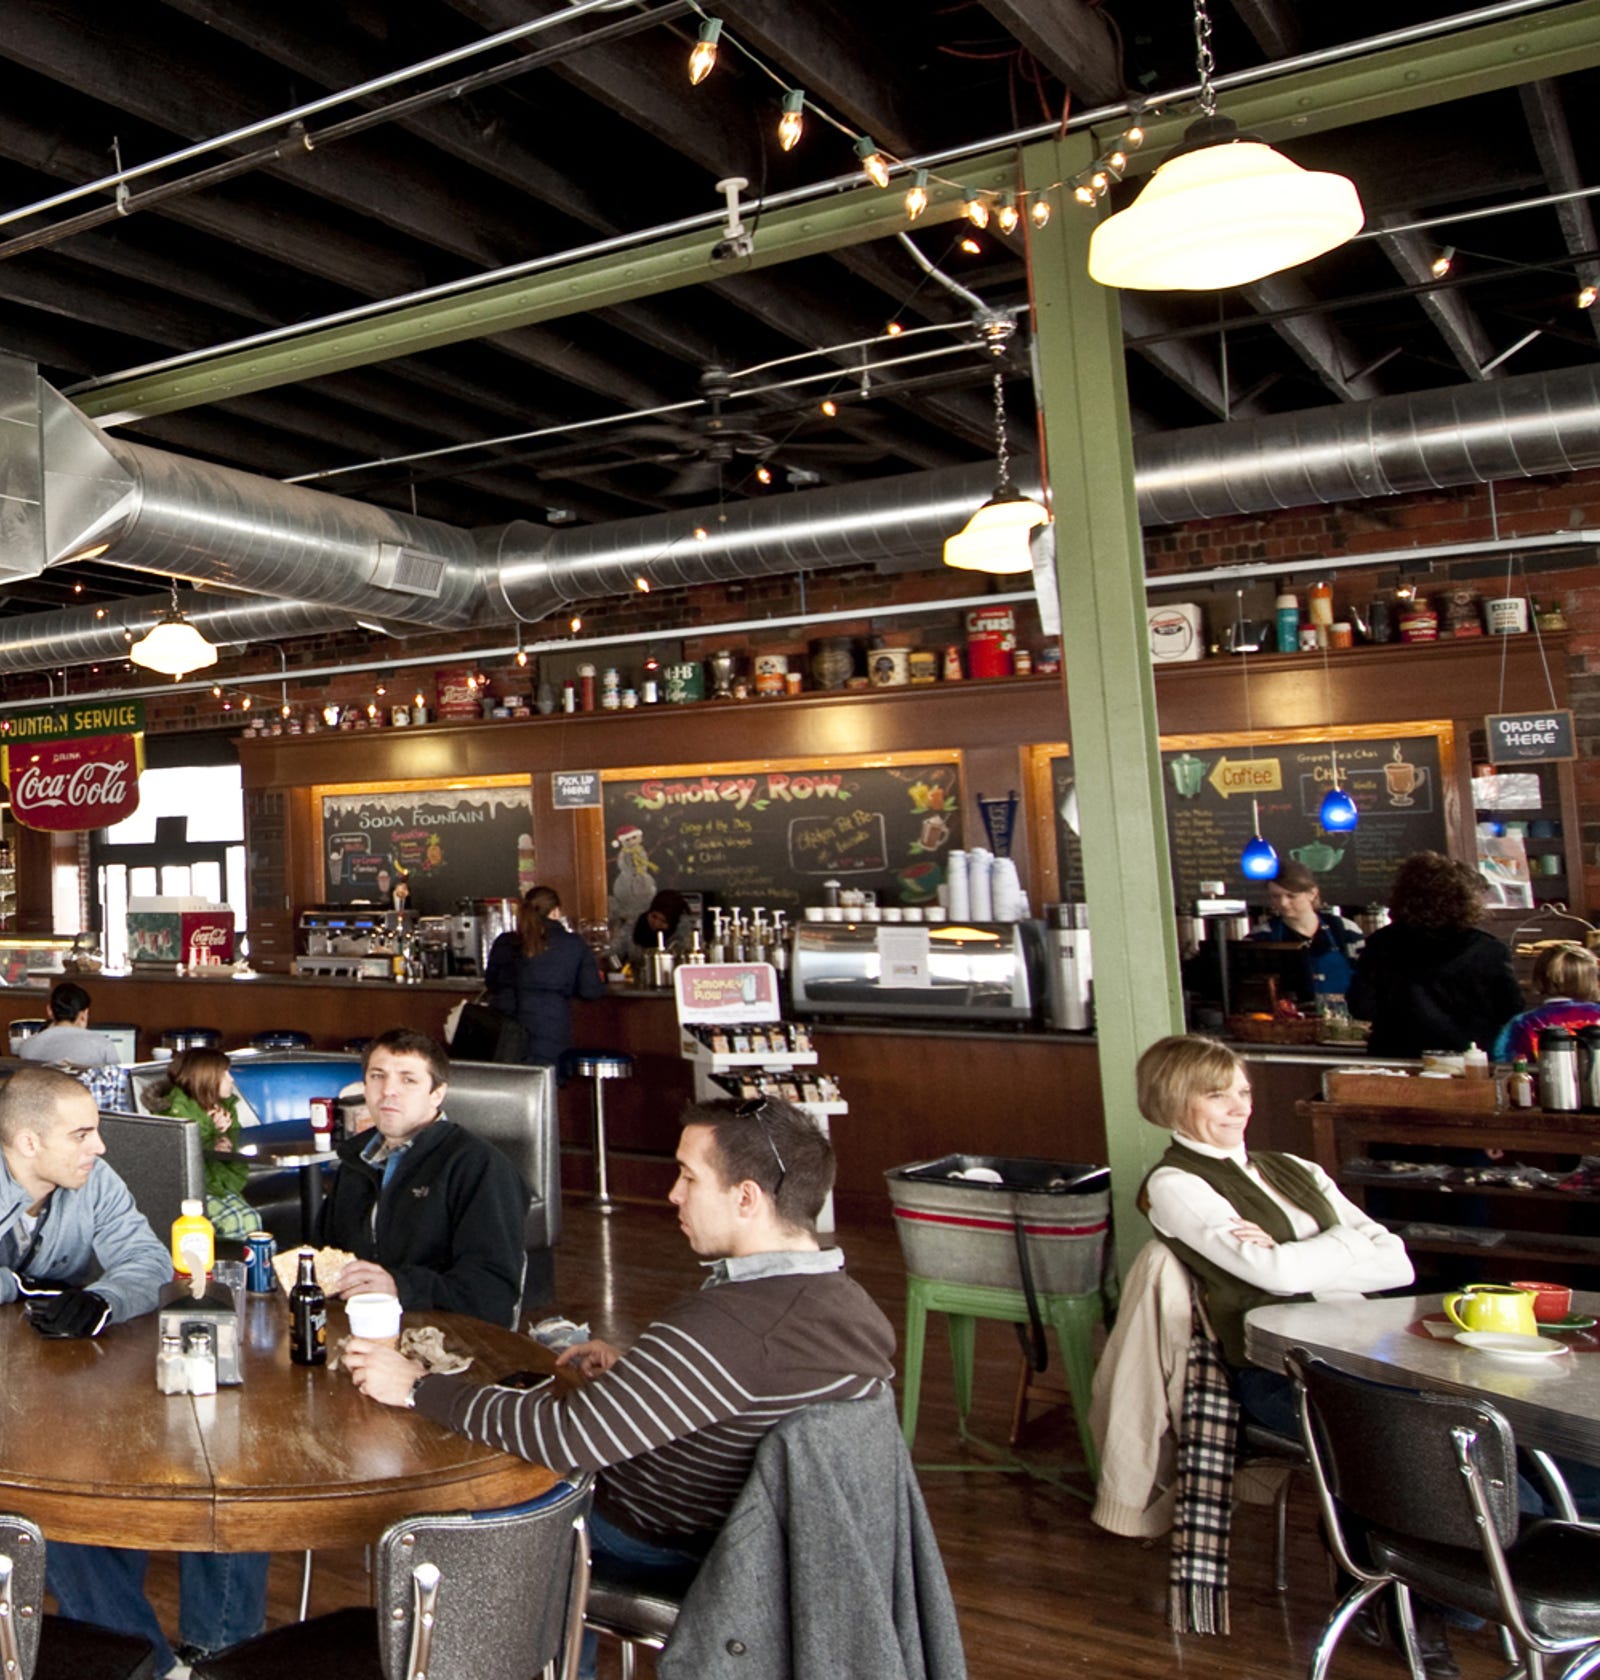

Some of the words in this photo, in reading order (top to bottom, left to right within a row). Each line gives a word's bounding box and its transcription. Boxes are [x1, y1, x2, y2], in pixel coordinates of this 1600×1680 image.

[74, 705, 137, 731] SERVICE
[1499, 718, 1560, 734] ORDER
[1505, 731, 1557, 747] HERE
[16, 760, 129, 810] Coca-Cola
[1222, 766, 1273, 786] Coffee
